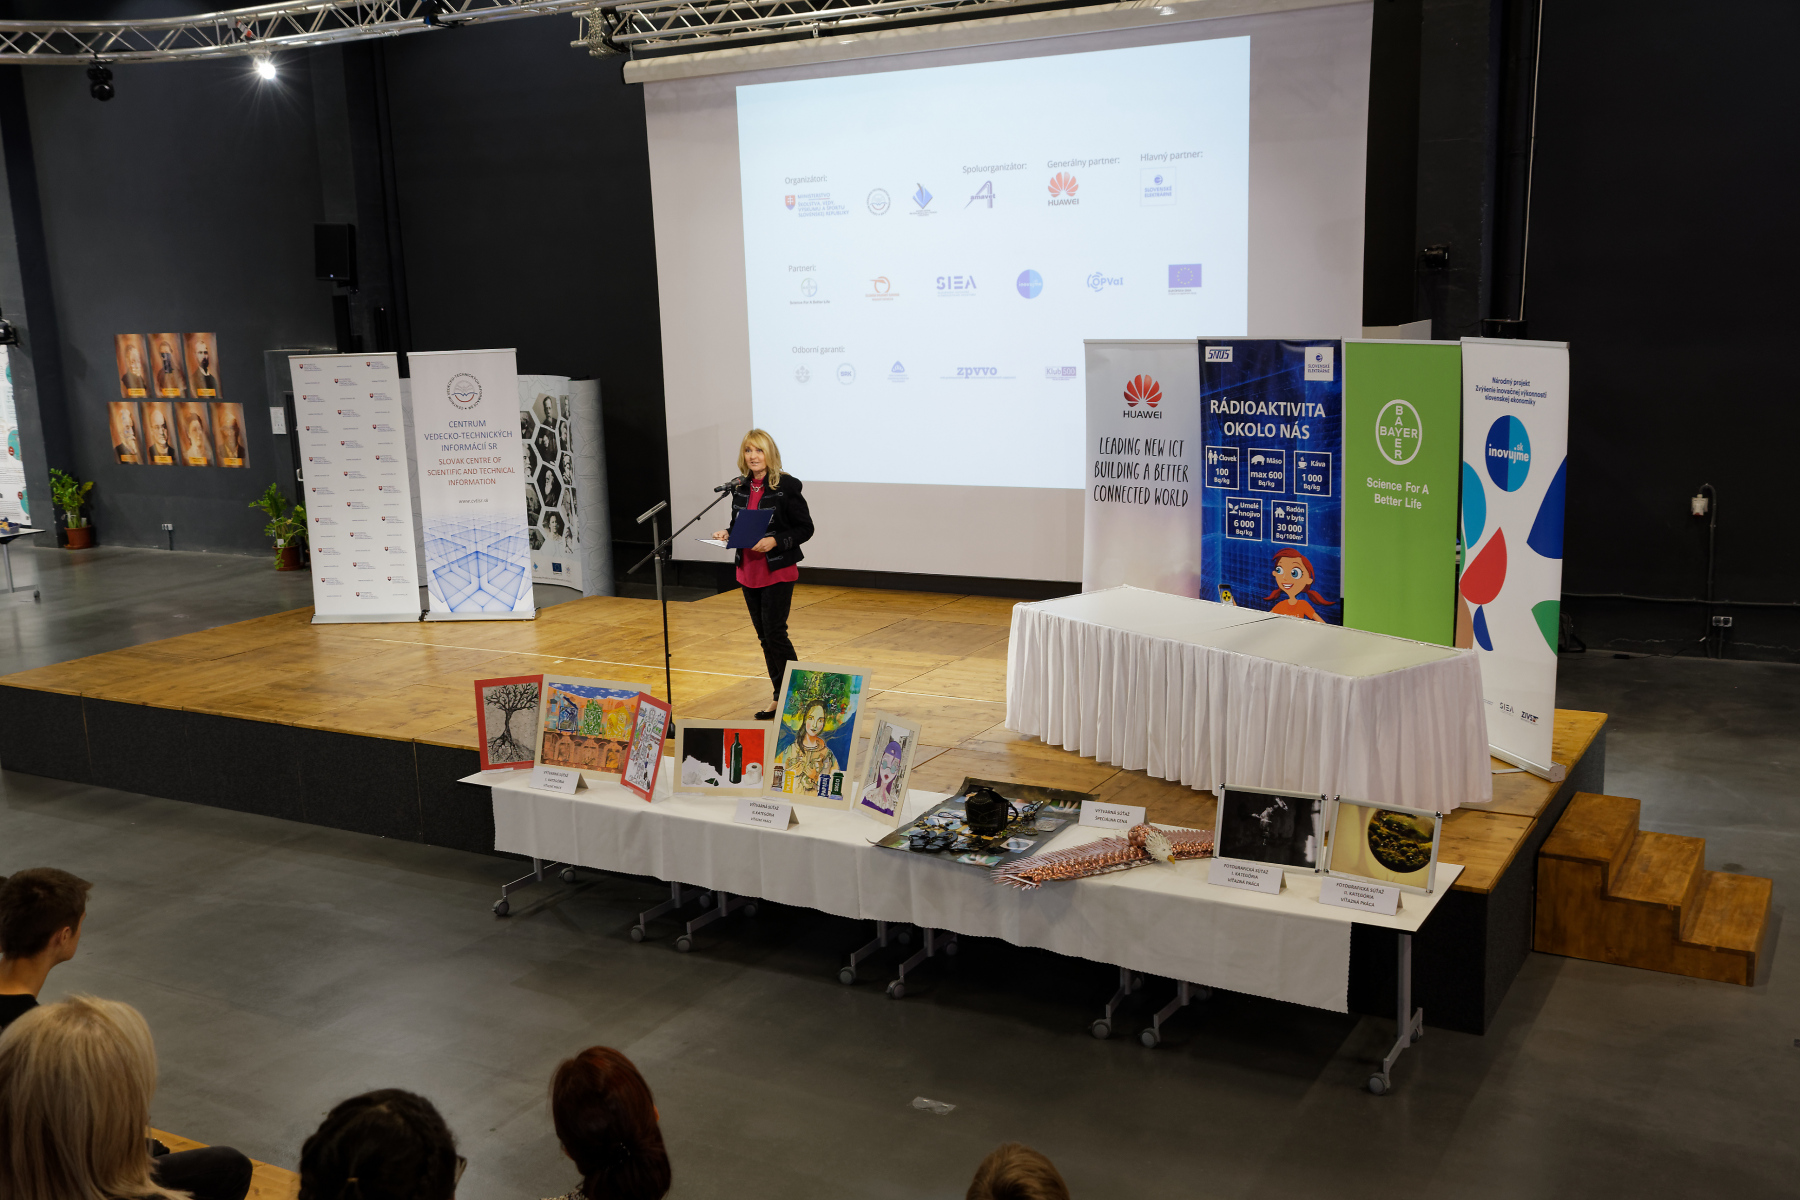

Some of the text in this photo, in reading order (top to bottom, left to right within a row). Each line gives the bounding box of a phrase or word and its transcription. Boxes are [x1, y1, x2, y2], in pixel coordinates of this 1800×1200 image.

[1140, 150, 1203, 162] Hlavný partner:
[962, 162, 1027, 174] Spoluorganizátor:
[1047, 156, 1120, 170] Generálny partner:
[784, 174, 828, 186] Organizátori:
[788, 264, 816, 272] Partneri:
[936, 276, 977, 290] SIEA
[820, 346, 845, 354] garanti:
[957, 366, 998, 379] zpvvo
[1062, 367, 1076, 376] 500
[1492, 377, 1512, 386] Národný
[1496, 387, 1520, 396] inovačnej
[1485, 395, 1536, 406] slovenskej ekonomiky
[1210, 396, 1326, 418] RÁDIOAKTIVITA
[1123, 410, 1162, 419] HUAWEI
[448, 420, 486, 428] CENTRUM
[424, 430, 512, 440] VEDECKO-TECHNICKÝCH
[1224, 421, 1310, 440] OKOLO NÁS
[1380, 426, 1418, 439] BAYER
[442, 442, 486, 452] INFORMÁCIÍ
[1100, 437, 1184, 458] LEADING NEW ICT
[1218, 454, 1238, 462] Človek
[1488, 444, 1529, 464] inovujme
[428, 468, 462, 476] SCIENTIFIC
[480, 466, 516, 474] TECHNICAL
[1094, 460, 1188, 482] BUILDING A BETTER
[1268, 471, 1283, 479] 600
[1366, 477, 1429, 494] Science For A
[1094, 485, 1188, 508] CONNECTED WORLD
[1374, 493, 1422, 509] Better Life
[1288, 524, 1302, 533] 000
[1224, 864, 1254, 872] FOTOGRAFICKÁ
[1336, 883, 1369, 892] FOTOGRAFICKÁ
